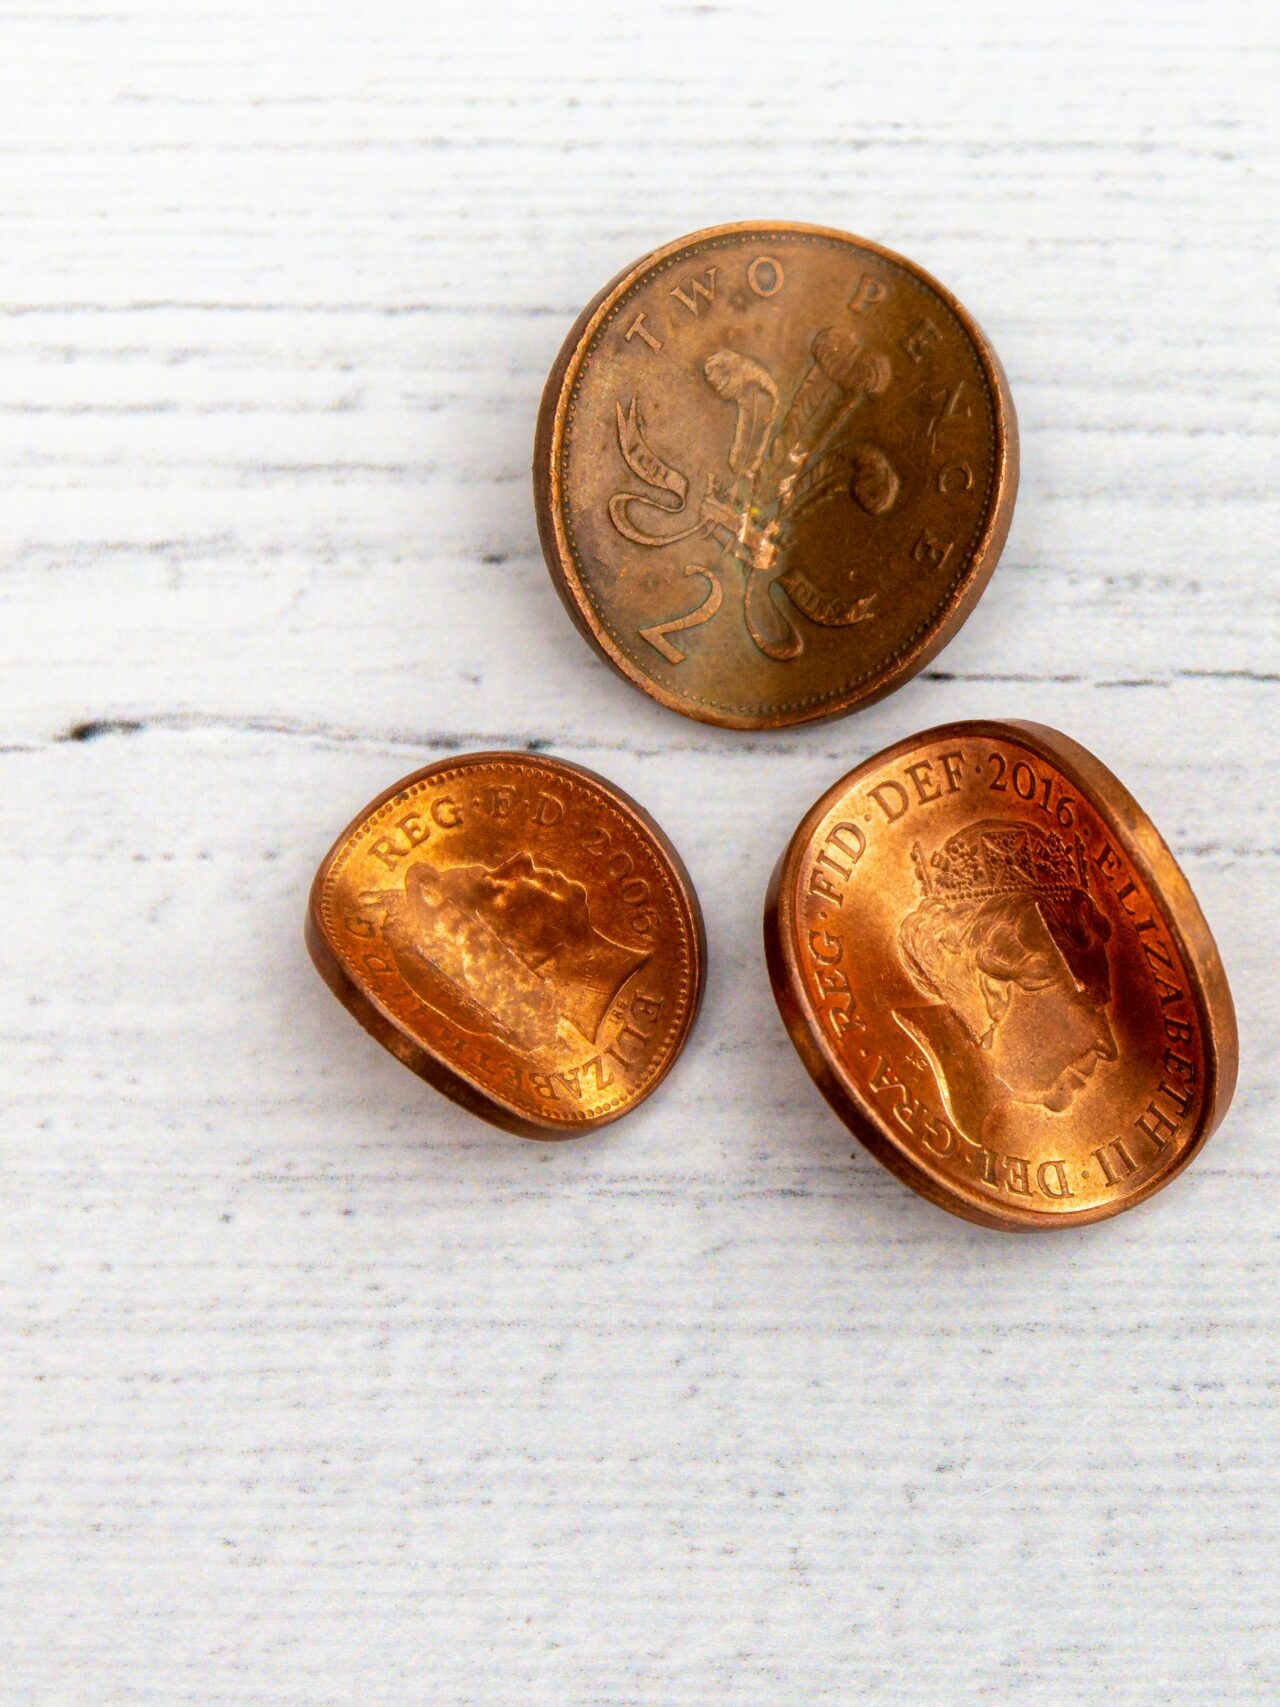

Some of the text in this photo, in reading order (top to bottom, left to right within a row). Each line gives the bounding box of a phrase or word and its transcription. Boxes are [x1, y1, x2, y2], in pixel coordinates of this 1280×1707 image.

[624, 256, 975, 570] TWO PENCE
[638, 565, 724, 664] 2
[367, 796, 464, 872] REG
[806, 751, 1197, 1199] ELIZABETH II DEI GRA REG FID DEF 2016
